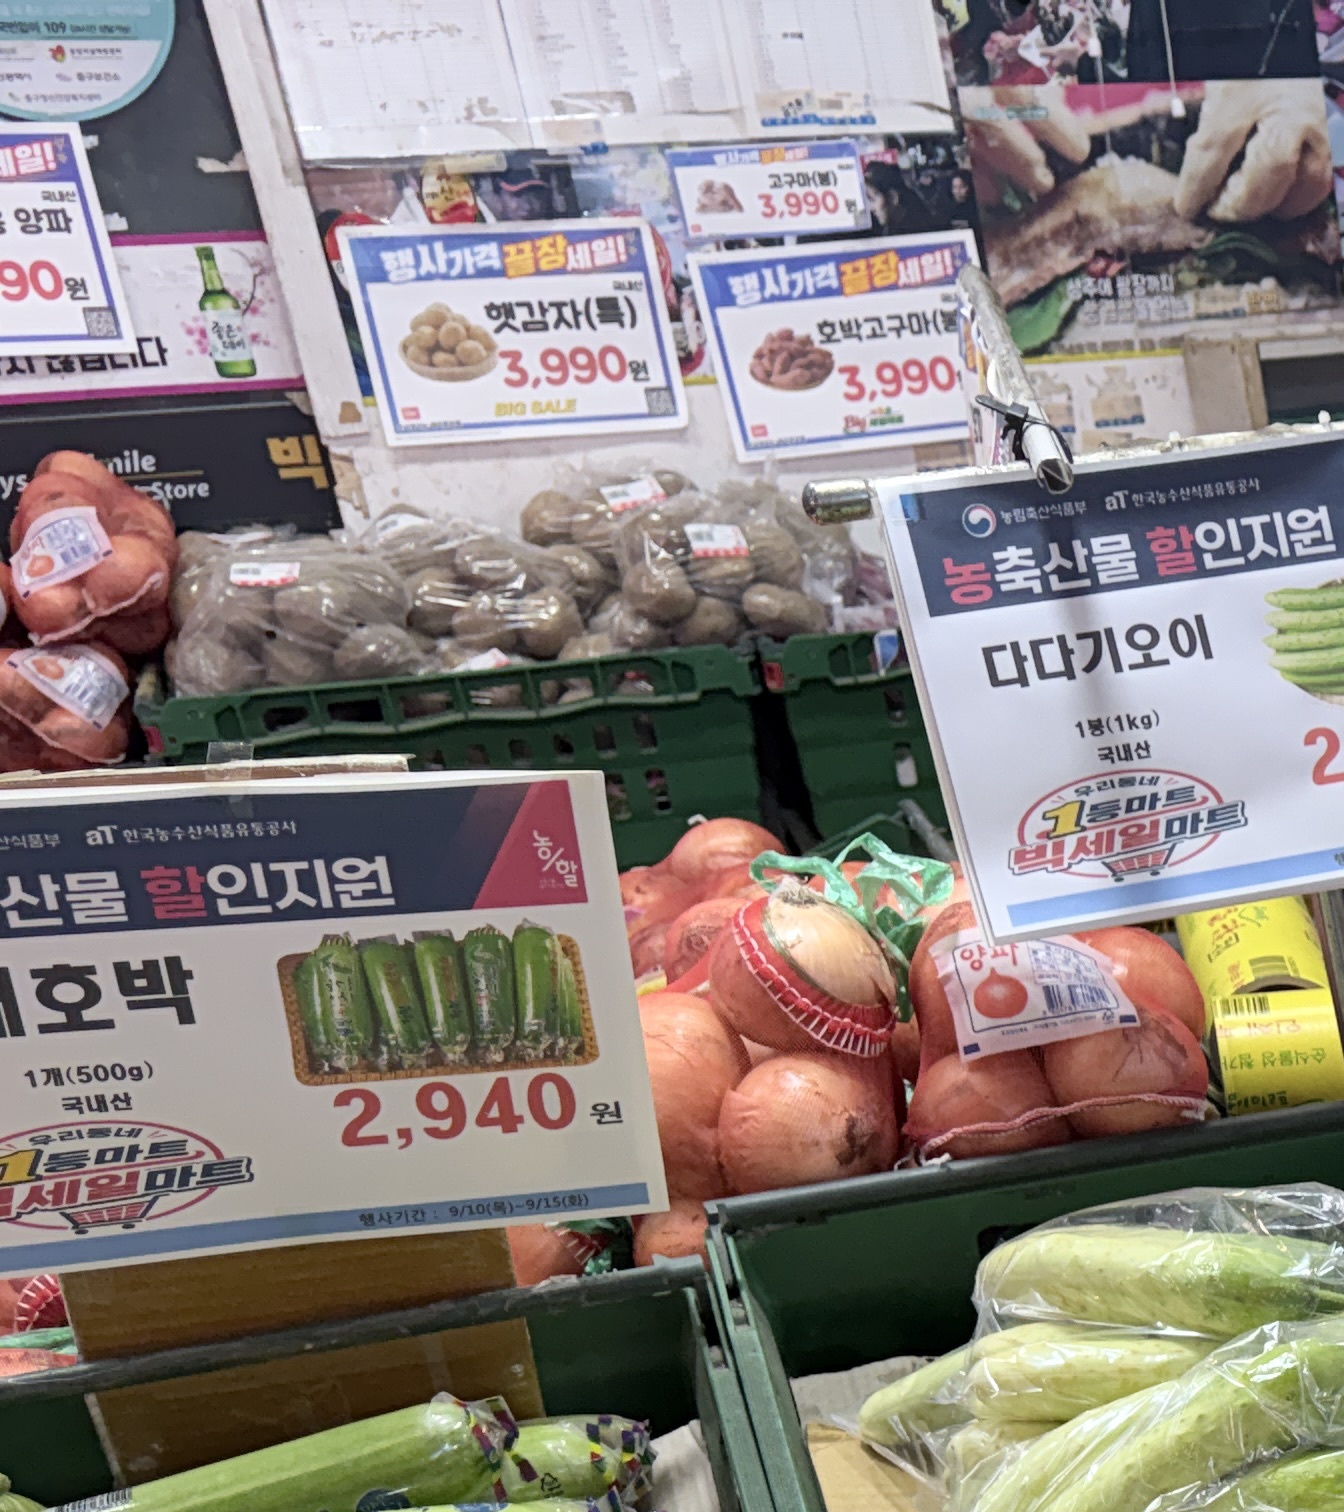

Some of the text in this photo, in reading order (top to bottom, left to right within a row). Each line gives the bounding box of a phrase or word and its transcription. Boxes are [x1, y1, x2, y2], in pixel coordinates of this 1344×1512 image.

[44, 22, 66, 34] 109
[758, 191, 839, 219] 3,990
[14, 208, 73, 234] 양파
[380, 241, 500, 284] 행사가격
[728, 262, 839, 308] 행사가격
[838, 356, 958, 403] 3,990
[495, 399, 577, 417] BIG SALE
[150, 481, 210, 501] Store
[1000, 477, 1260, 526] 농림축산식품부 aT 한국농수산식품유통공사
[943, 504, 1337, 606] 농축산물 할인지원
[981, 614, 1214, 690] 다다기오이
[1075, 709, 1160, 740] 1봉(1kg)
[1097, 741, 1152, 765] 국내산
[1073, 774, 1160, 796] 우리동네
[1041, 783, 1199, 840] 1등마트
[86, 823, 118, 846] aT
[122, 819, 297, 844] 한국농수산식품유통공사
[1010, 800, 1247, 875] 빅세일마트
[140, 855, 396, 920] 할인지원
[24, 1061, 154, 1090] 1개(500g)
[61, 1091, 134, 1116] 국내산
[332, 1072, 624, 1150] 2,940 원
[28, 1125, 143, 1147] 우리동네
[359, 1208, 427, 1229] 행사기간
